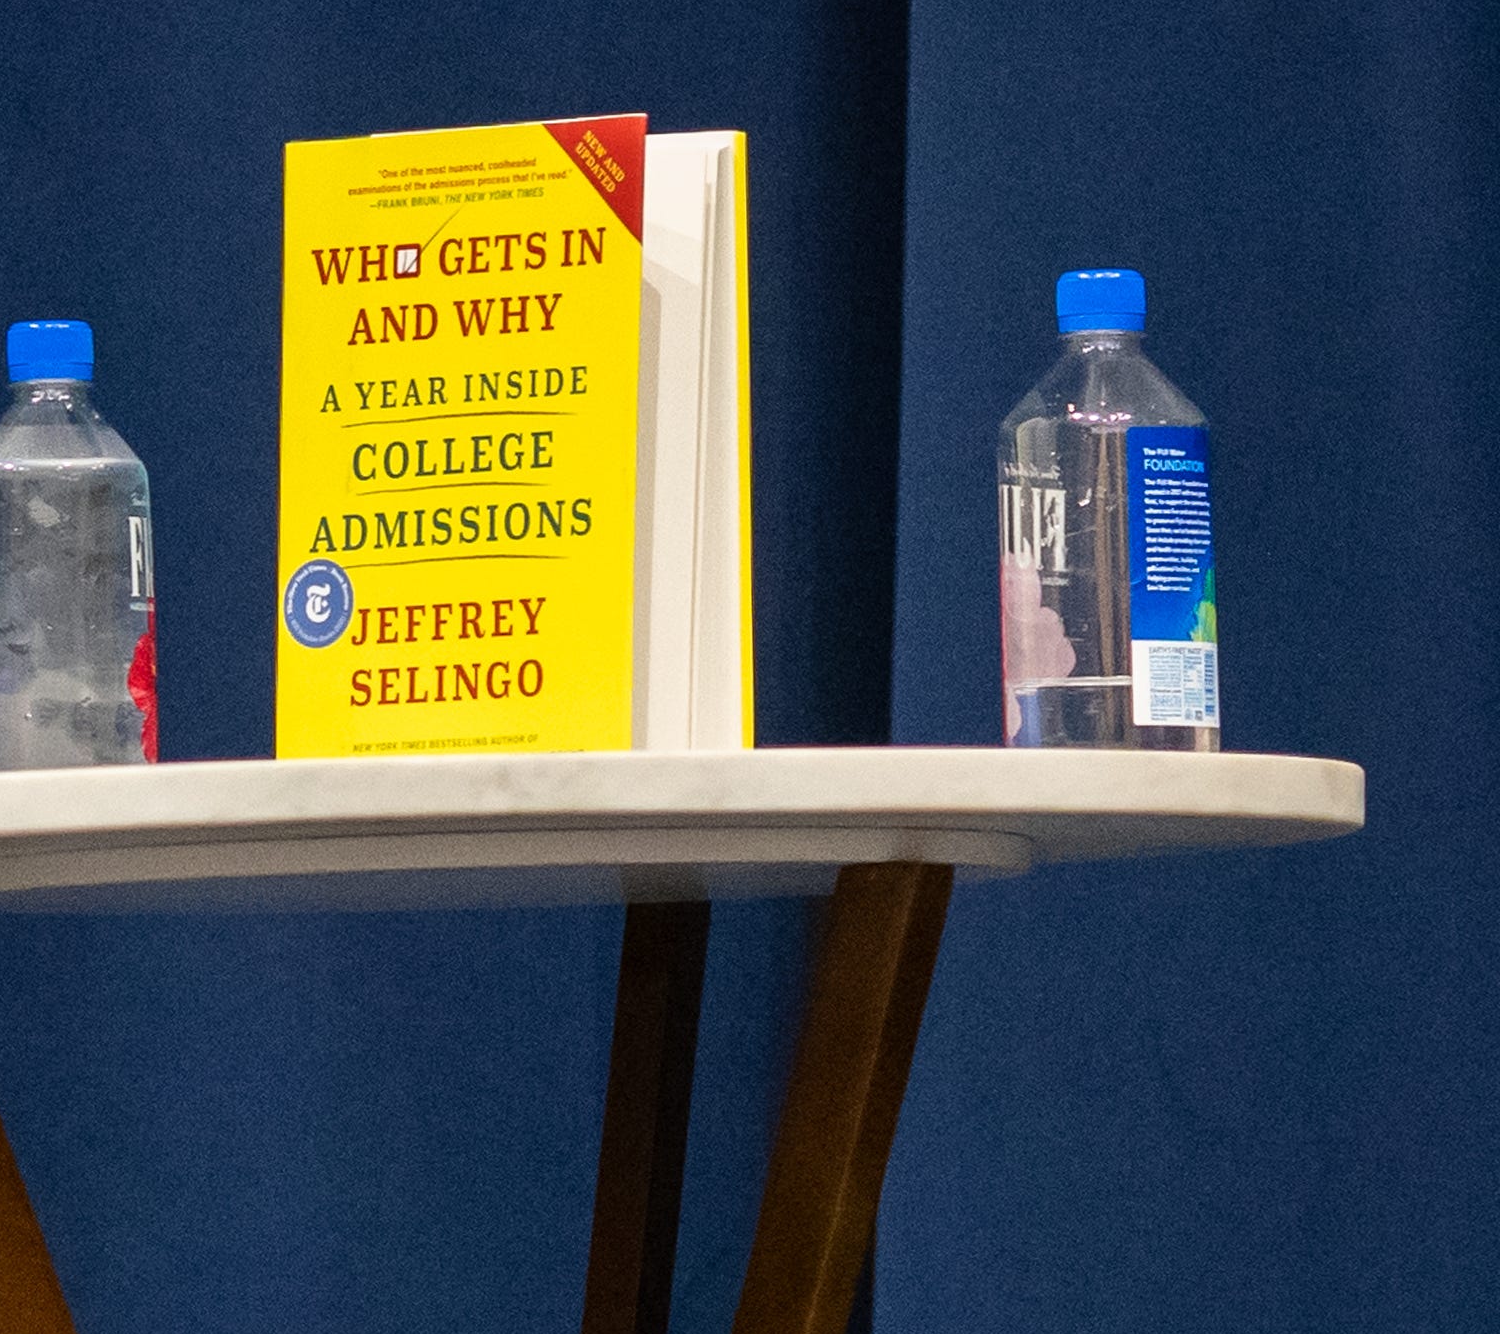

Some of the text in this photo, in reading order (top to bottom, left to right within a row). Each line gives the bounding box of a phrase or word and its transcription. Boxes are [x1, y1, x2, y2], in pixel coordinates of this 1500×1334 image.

[400, 168, 409, 178] of
[410, 167, 424, 177] the
[426, 166, 446, 176] most
[488, 158, 537, 170] coolheaded
[575, 141, 617, 193] UPDATED
[583, 130, 626, 183] NEW AND
[348, 185, 402, 196] examinations
[403, 182, 413, 192] of
[414, 181, 427, 191] the
[430, 179, 476, 190] admissions
[478, 176, 511, 187] process
[512, 173, 529, 183] that
[445, 193, 463, 205] THE
[464, 192, 486, 203] NEW
[489, 189, 513, 201] YORK
[517, 186, 545, 199] TIMES
[438, 232, 547, 276] GETS
[560, 227, 606, 267] IN
[347, 293, 563, 346] AND WHY
[320, 365, 588, 413] A YEAR INSIDE
[352, 430, 554, 482] COLLEGE
[309, 498, 593, 554] ADMISSIONS
[351, 597, 547, 647] JEFFREY
[350, 659, 544, 708] SELINGO
[375, 741, 398, 751] YORK
[401, 739, 427, 750] TIMES
[428, 736, 488, 749] BESTSELLING
[490, 734, 526, 746] AUTHOR
[527, 733, 539, 743] OF
